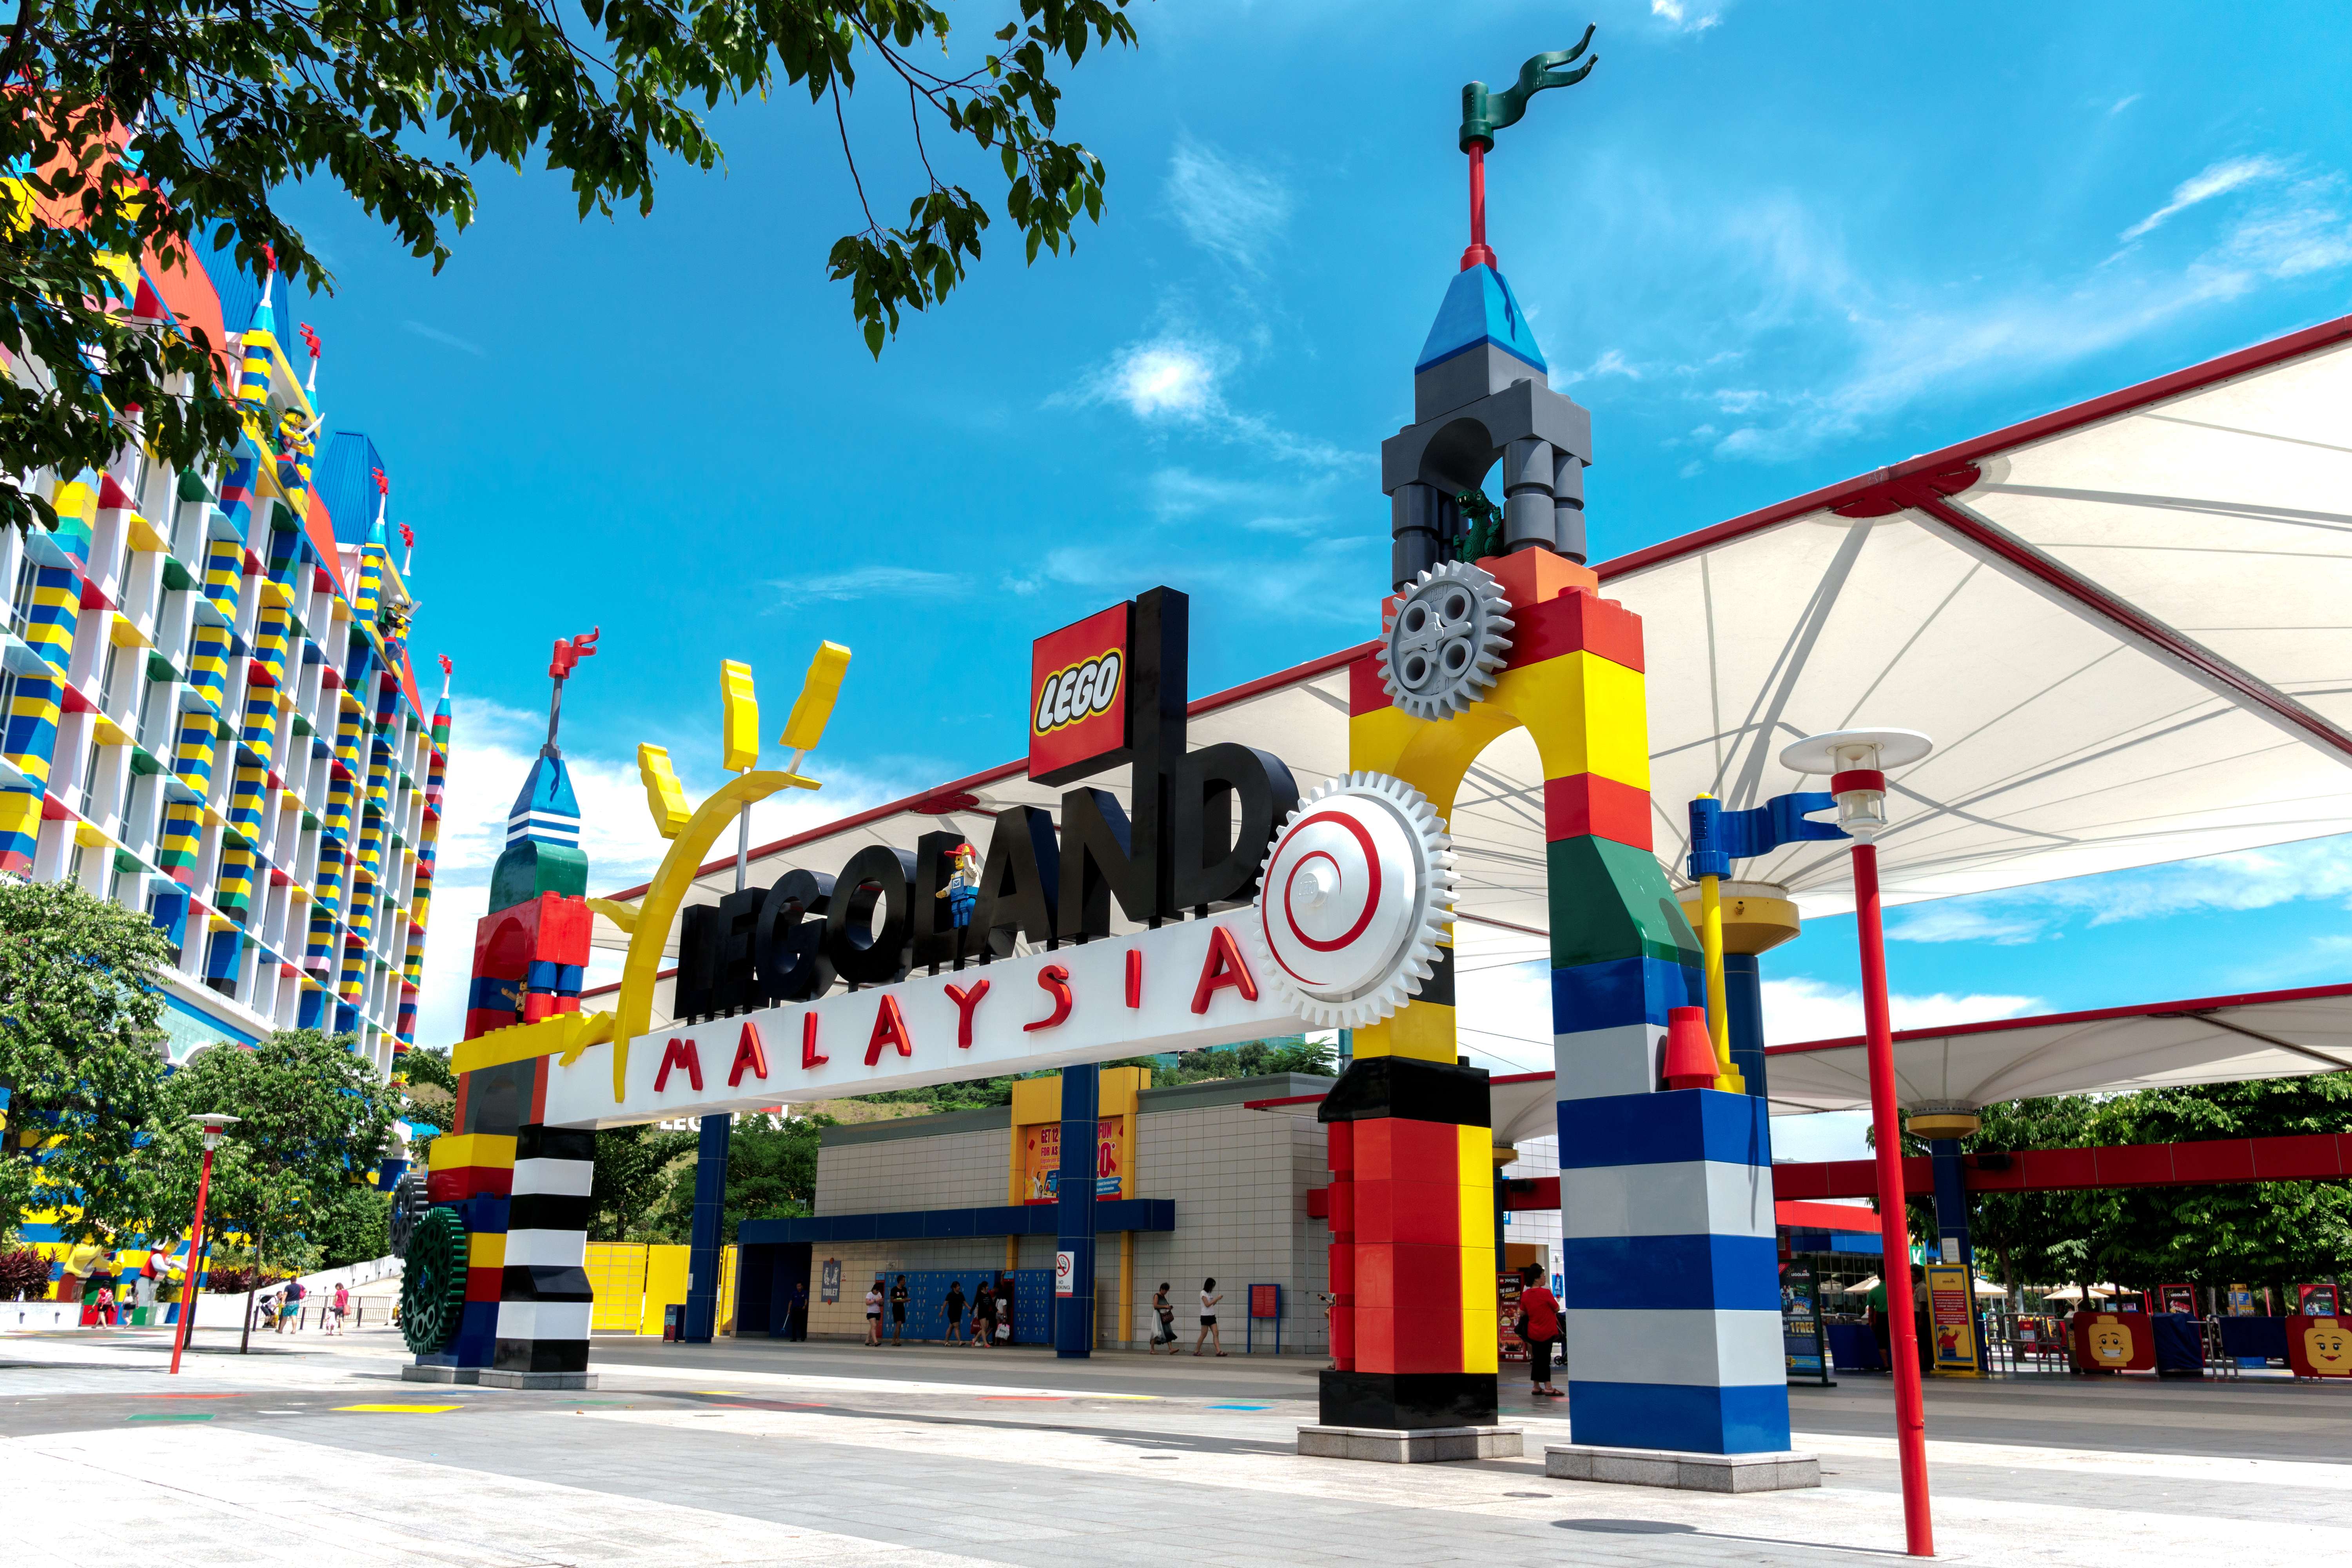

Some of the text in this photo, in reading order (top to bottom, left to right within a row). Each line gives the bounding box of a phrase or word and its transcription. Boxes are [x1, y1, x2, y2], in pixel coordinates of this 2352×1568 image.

[1036, 652, 1120, 731] LEGO
[674, 586, 1299, 1020] LEGOLAND
[654, 926, 1258, 1092] MALAYSIA
[1041, 1121, 1112, 1143] GET 12 FUN
[1041, 1145, 1058, 1157] FOR AS
[1790, 1322, 1795, 1333] 1
[1795, 1322, 1815, 1333] FREE
